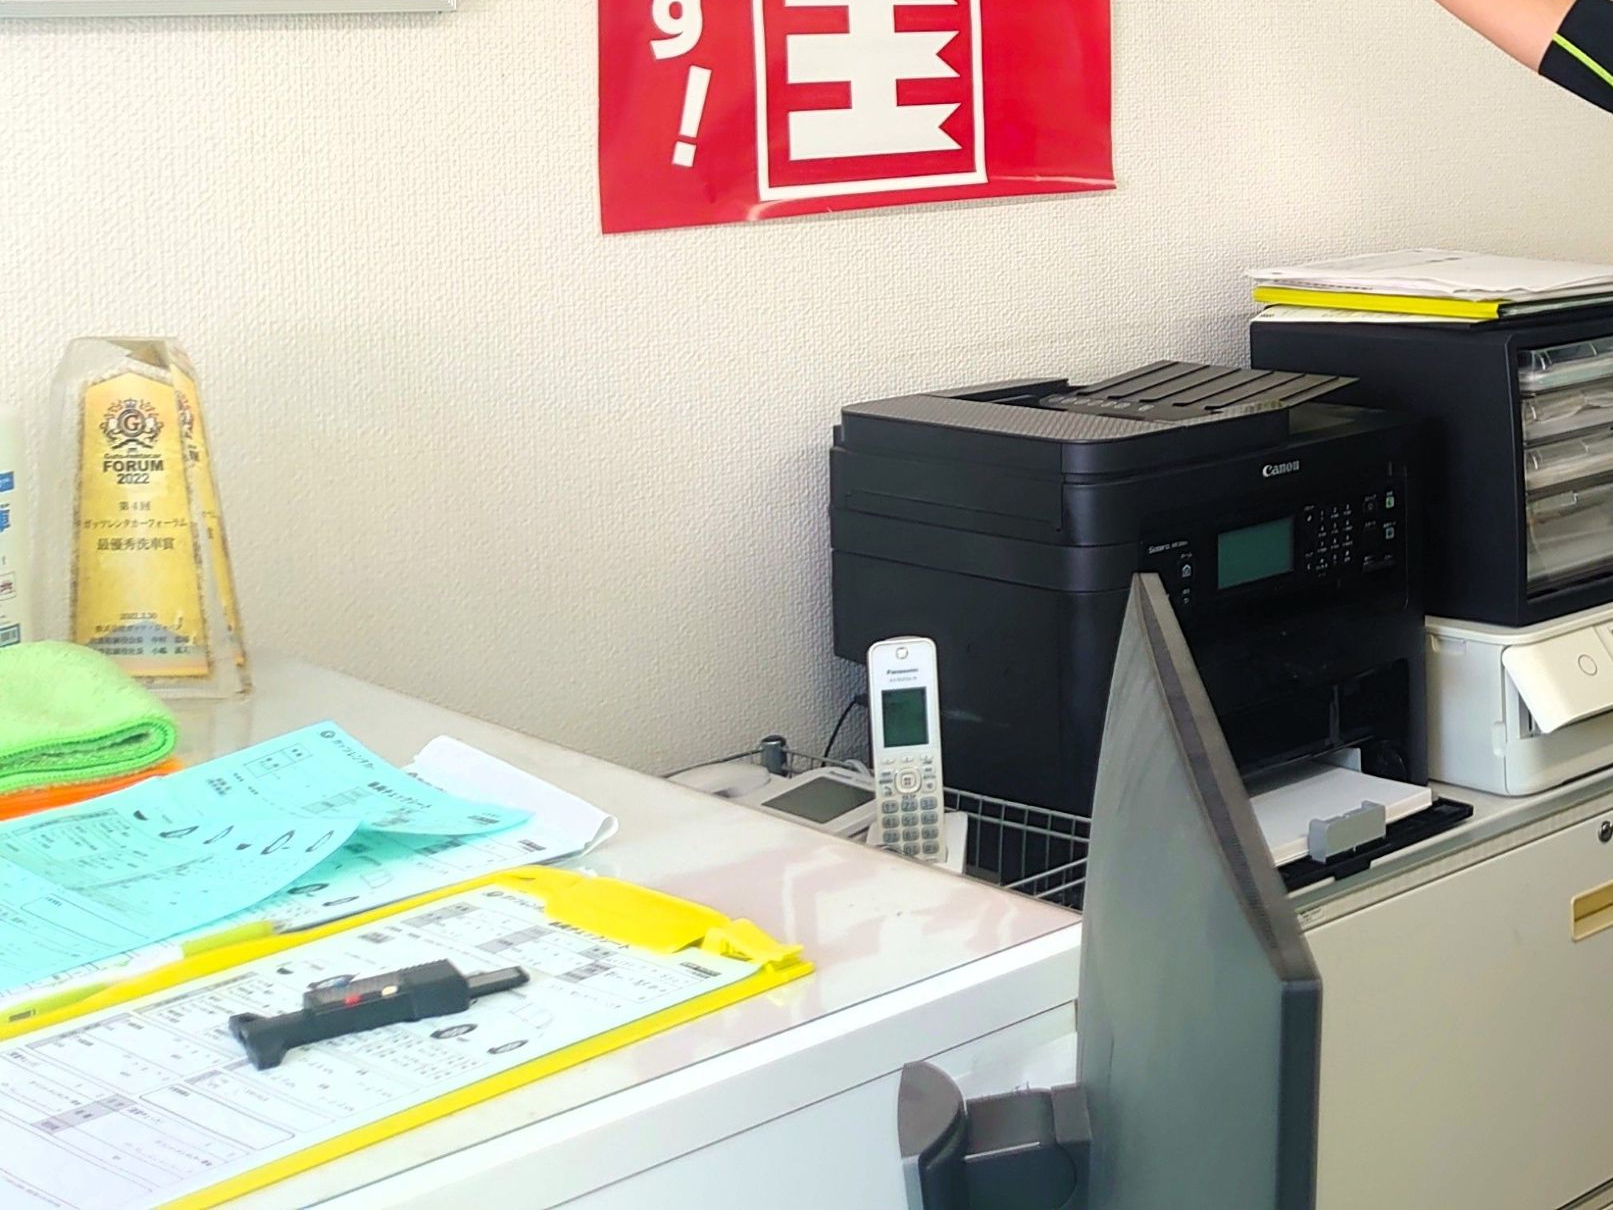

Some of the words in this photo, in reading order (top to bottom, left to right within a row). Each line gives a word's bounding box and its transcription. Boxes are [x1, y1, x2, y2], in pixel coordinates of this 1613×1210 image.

[102, 460, 165, 473] FORUM
[1262, 460, 1300, 477] Canon
[116, 473, 151, 485] 2022
